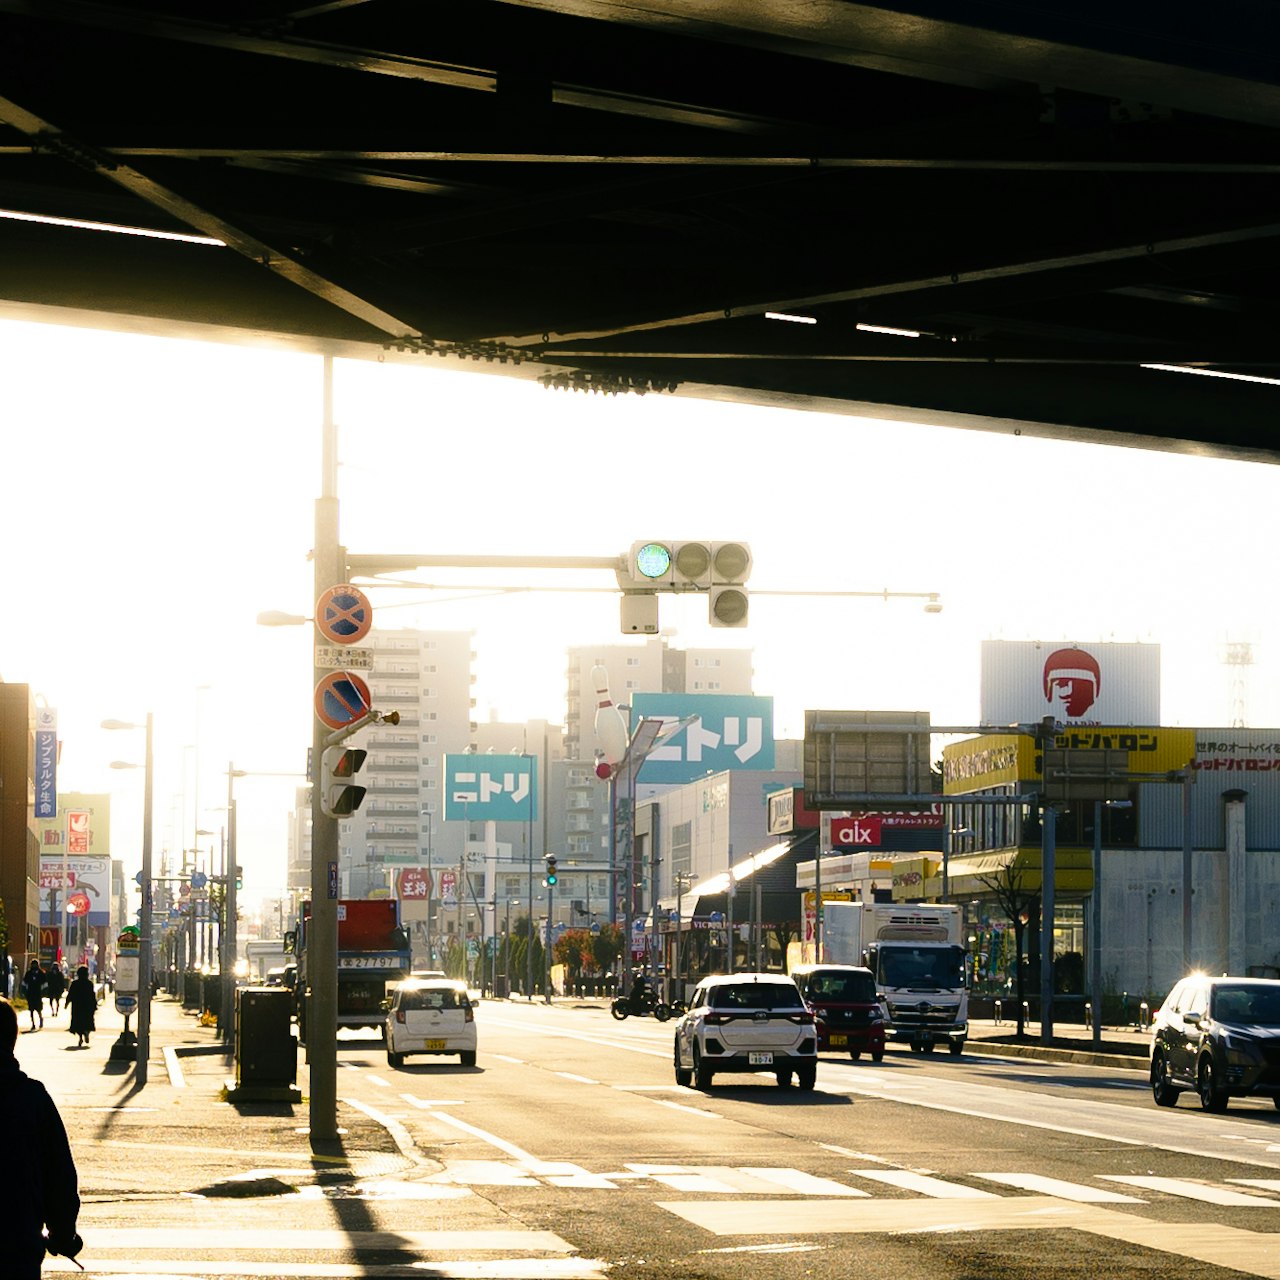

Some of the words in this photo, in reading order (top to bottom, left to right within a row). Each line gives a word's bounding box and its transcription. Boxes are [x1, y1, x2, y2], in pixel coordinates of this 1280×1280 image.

[644, 714, 763, 764] ニトリ
[39, 734, 53, 815] ジブラルタ生命
[453, 772, 530, 804] ニトリ
[839, 821, 872, 844] aix
[403, 881, 427, 896] 王将
[356, 958, 393, 968] 27797
